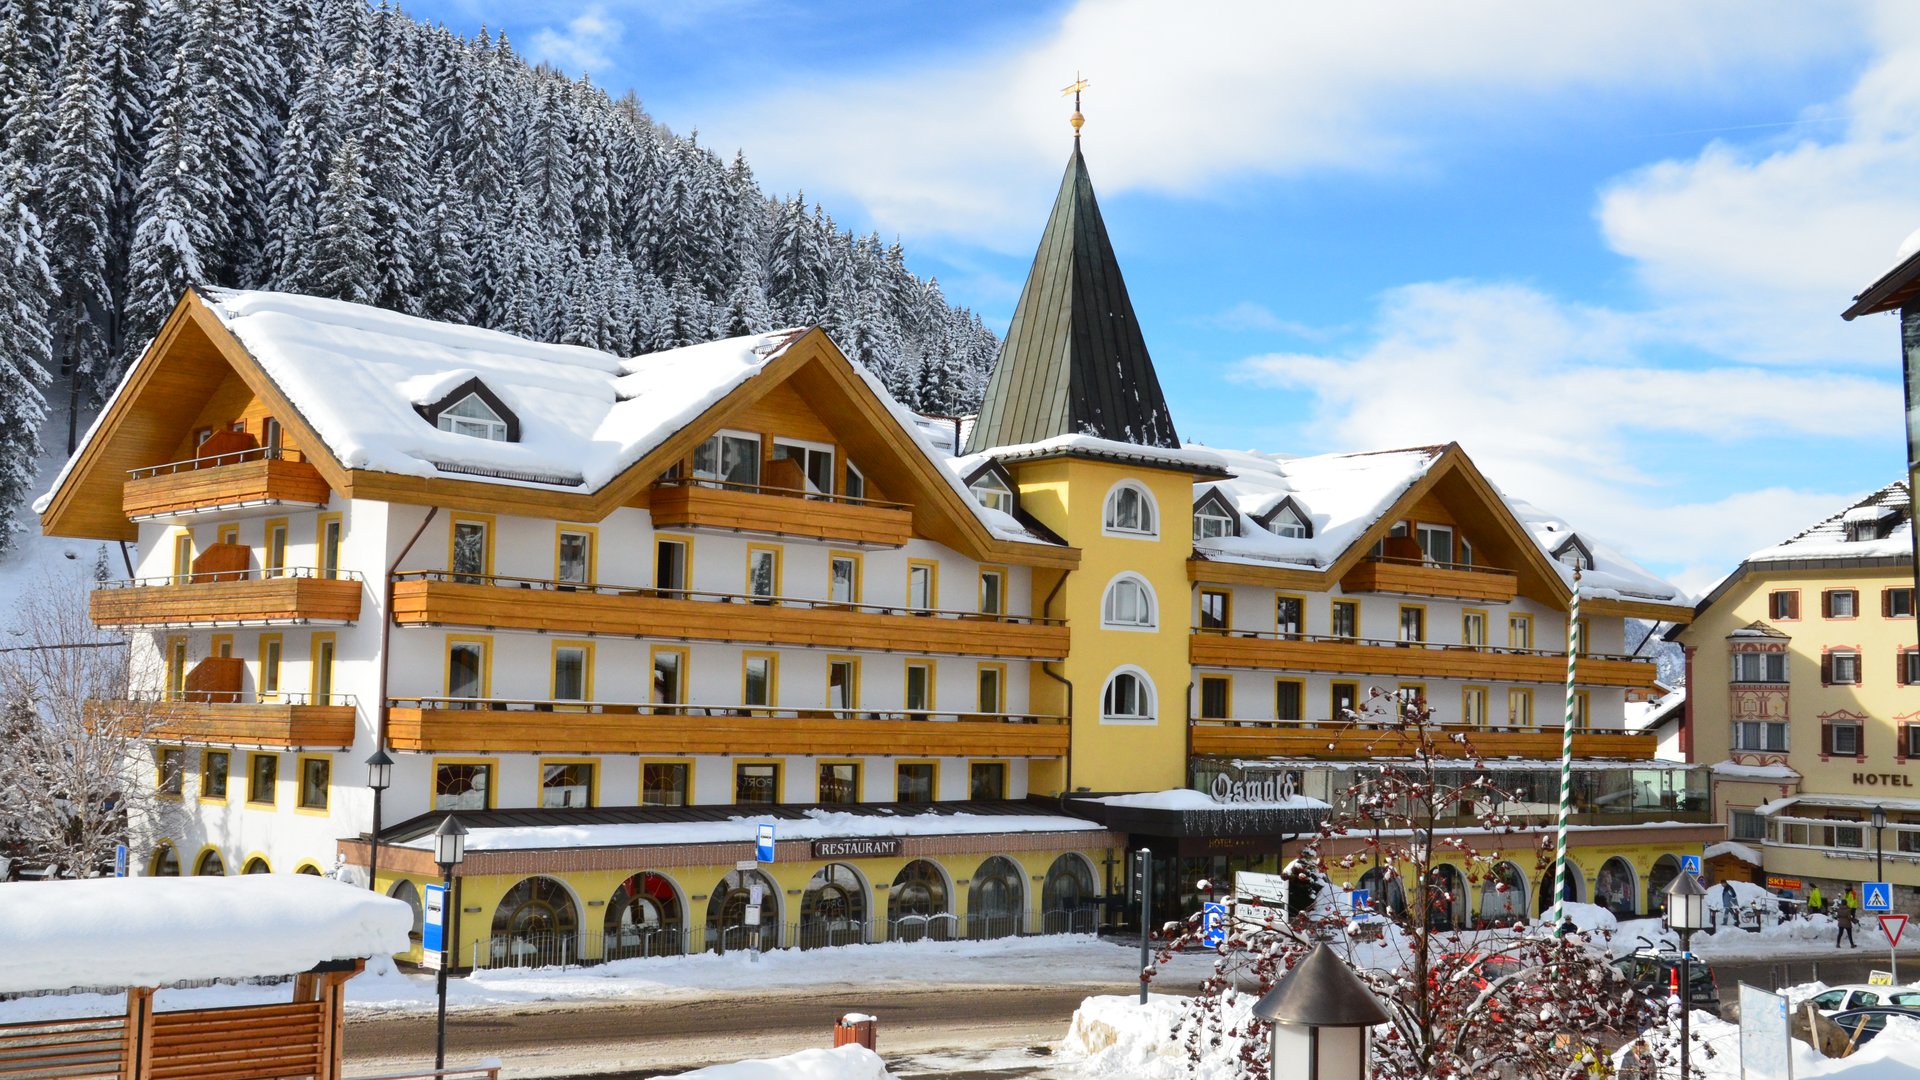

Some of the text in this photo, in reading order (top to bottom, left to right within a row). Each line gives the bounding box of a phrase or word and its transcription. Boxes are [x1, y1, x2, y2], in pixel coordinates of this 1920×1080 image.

[1853, 773, 1913, 787] HOTEL
[1211, 773, 1294, 802] Oswald
[821, 841, 896, 855] RESTAURANT
[1768, 877, 1784, 886] SKI
